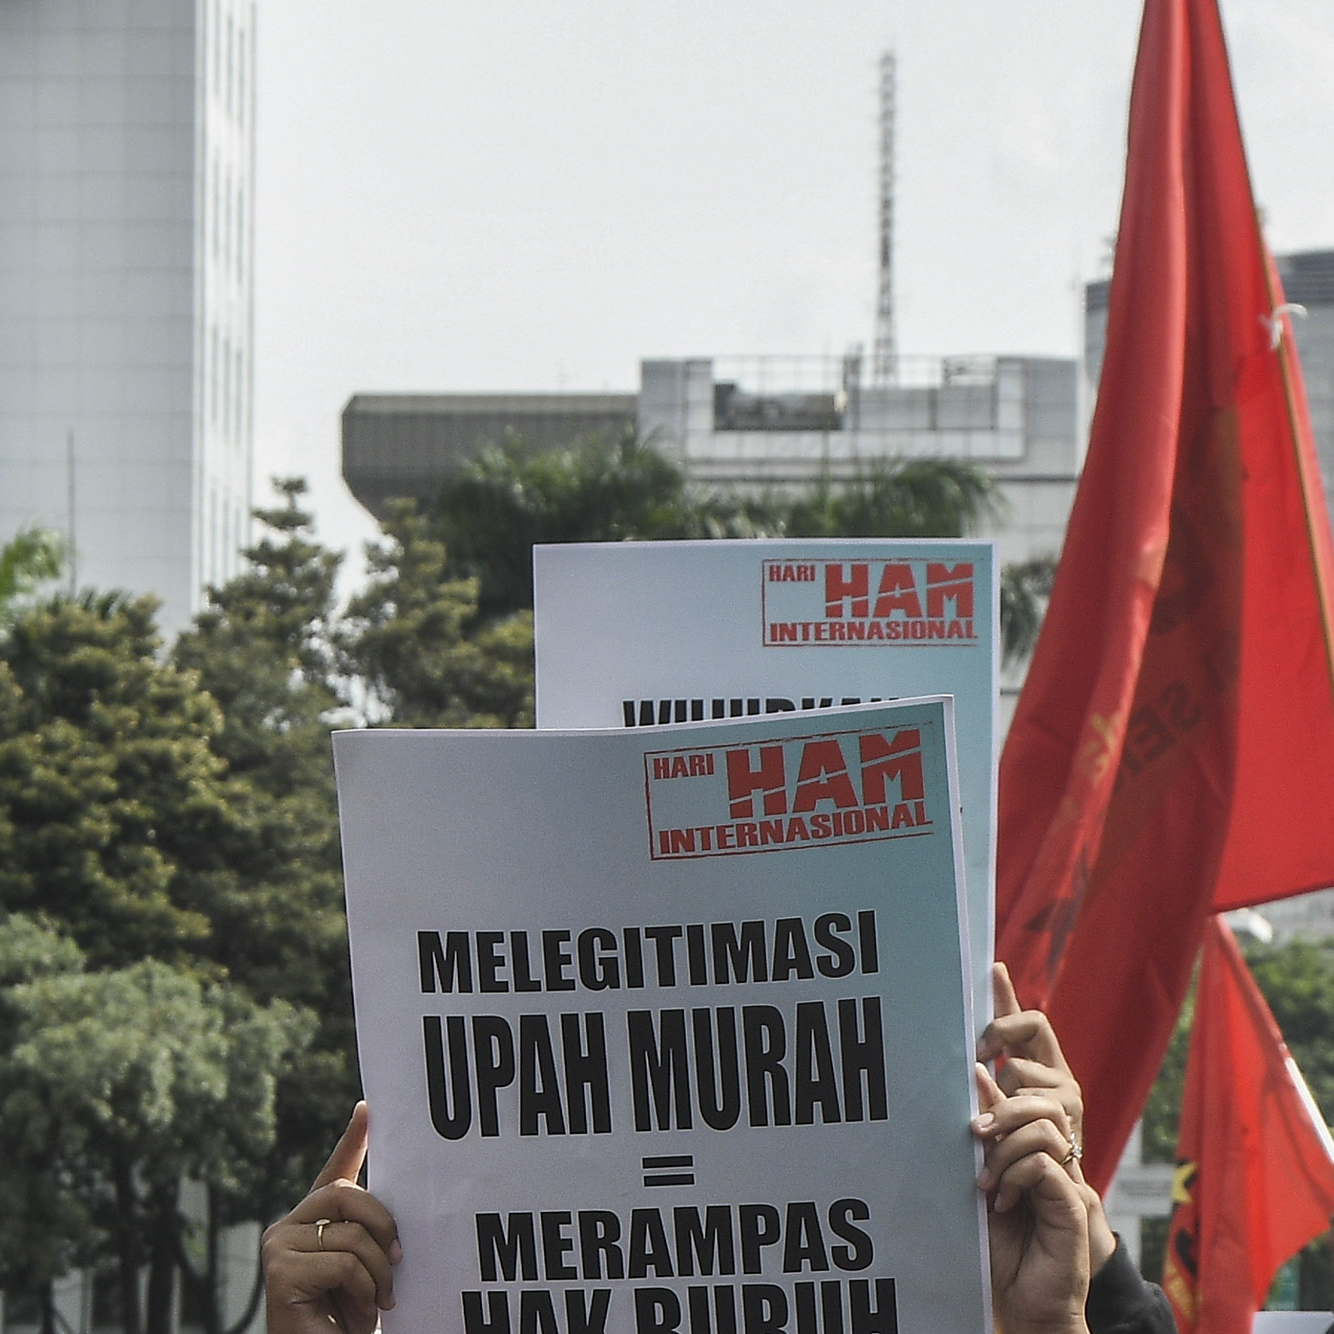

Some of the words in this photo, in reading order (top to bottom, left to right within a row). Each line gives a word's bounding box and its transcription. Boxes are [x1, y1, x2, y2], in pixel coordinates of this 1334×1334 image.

[770, 566, 815, 580] HARI
[826, 563, 974, 618] HAM
[770, 620, 973, 642] INTERNASIONAL
[653, 753, 714, 780] HARI
[725, 728, 926, 820] HAM
[659, 801, 933, 855] INTERNASIONAL
[417, 909, 879, 994] MELEGITIMASI
[422, 1011, 613, 1141] UPAH
[626, 995, 889, 1133] MURAH
[641, 1154, 695, 1188] =
[475, 1198, 874, 1283] MERAMPAS
